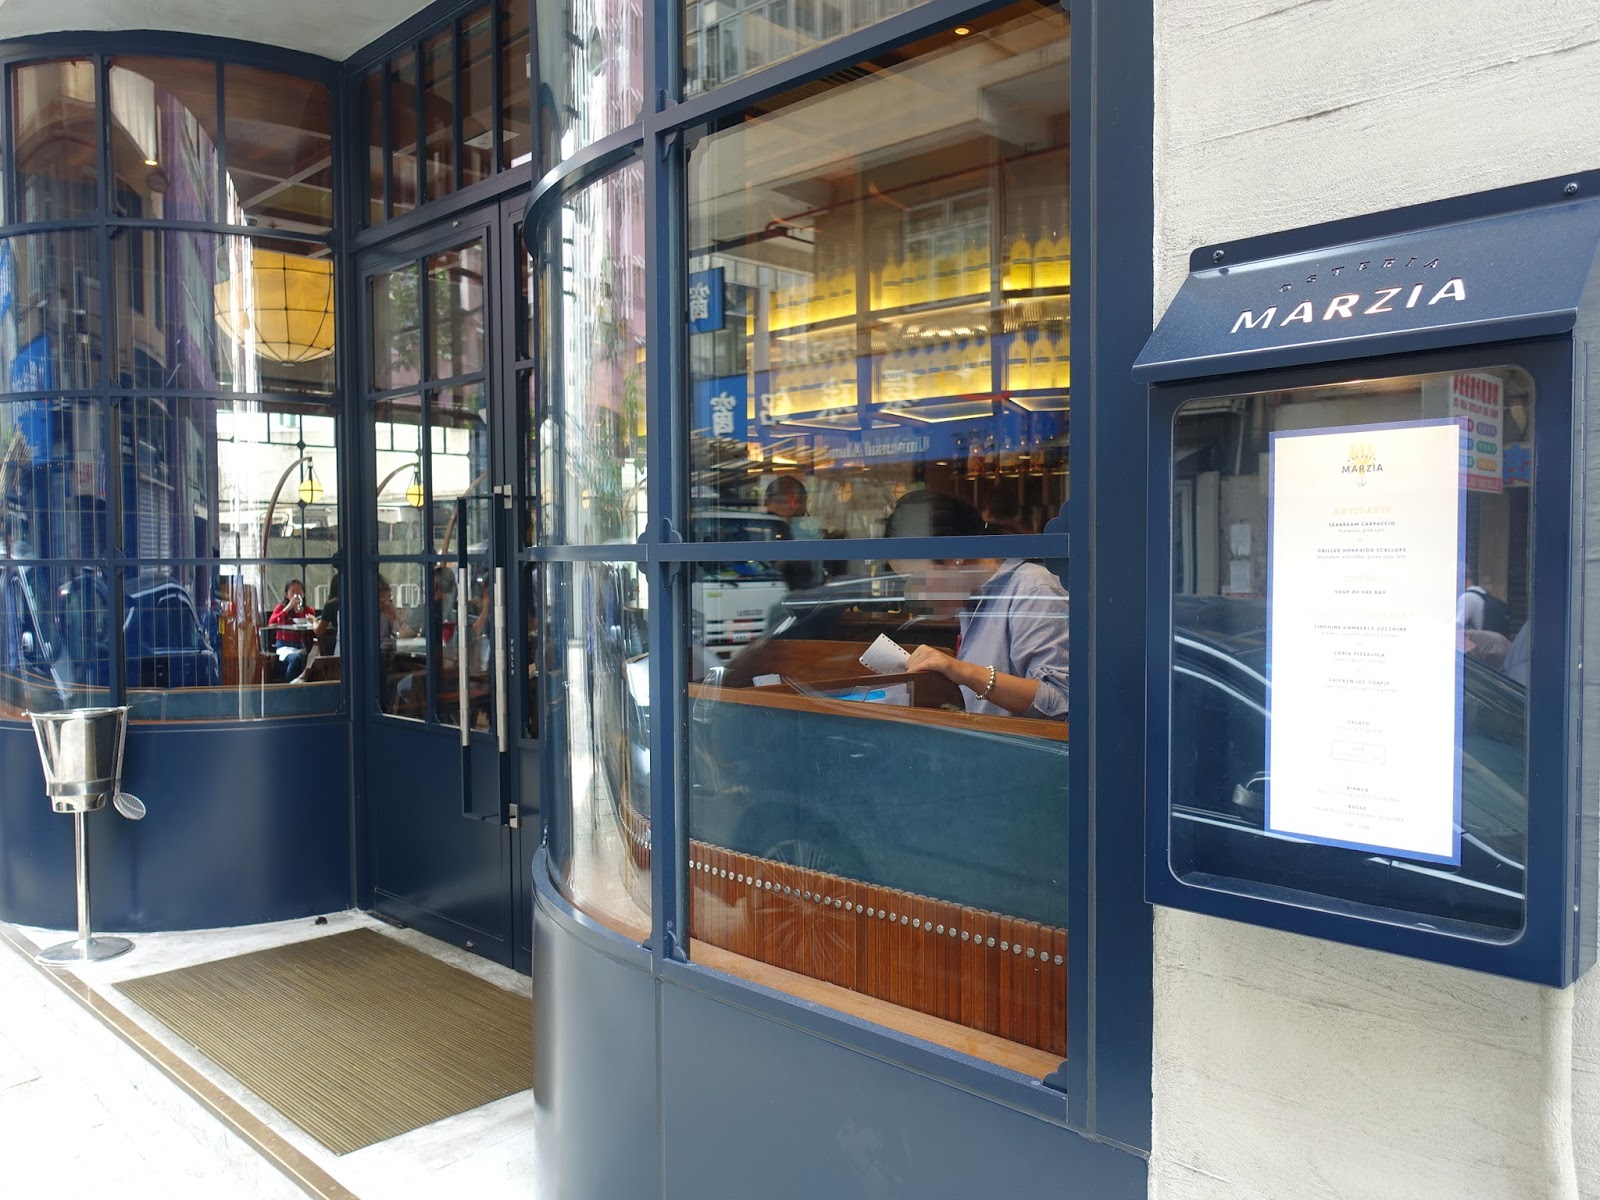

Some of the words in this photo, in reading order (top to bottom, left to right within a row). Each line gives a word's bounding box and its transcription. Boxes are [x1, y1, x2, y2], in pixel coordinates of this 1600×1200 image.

[1230, 276, 1467, 334] MARZIA
[1341, 463, 1384, 474] MARZIA
[1346, 719, 1371, 727] GELATO
[1346, 785, 1369, 793] BIANCO
